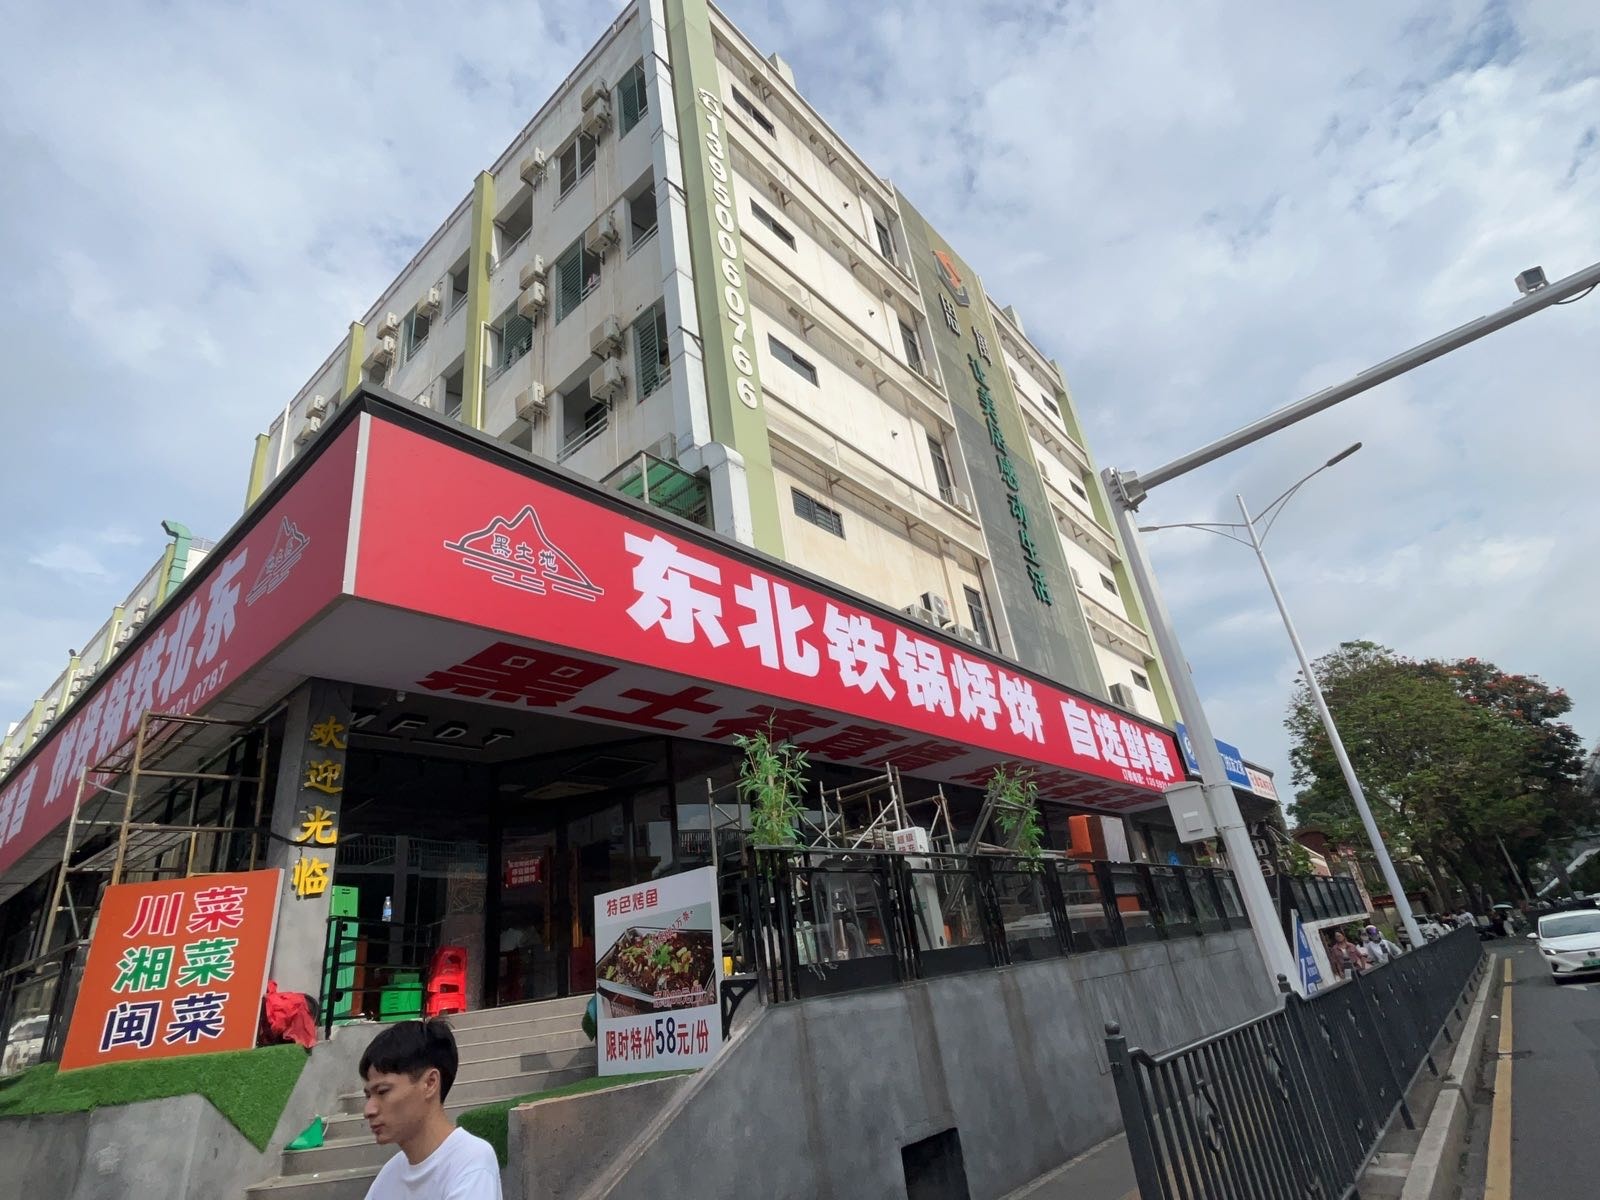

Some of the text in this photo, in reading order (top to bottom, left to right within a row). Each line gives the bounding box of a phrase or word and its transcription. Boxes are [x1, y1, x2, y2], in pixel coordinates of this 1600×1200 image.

[491, 534, 558, 574] 黑土地
[193, 660, 228, 705] 0787
[291, 715, 347, 897] 欢迎光临
[123, 885, 247, 939] 川菜
[606, 888, 658, 917] 特色烤鱼
[112, 937, 238, 993] 湘菜
[99, 992, 229, 1053] 闽菜
[605, 1016, 709, 1062] 限时特价58元/份
